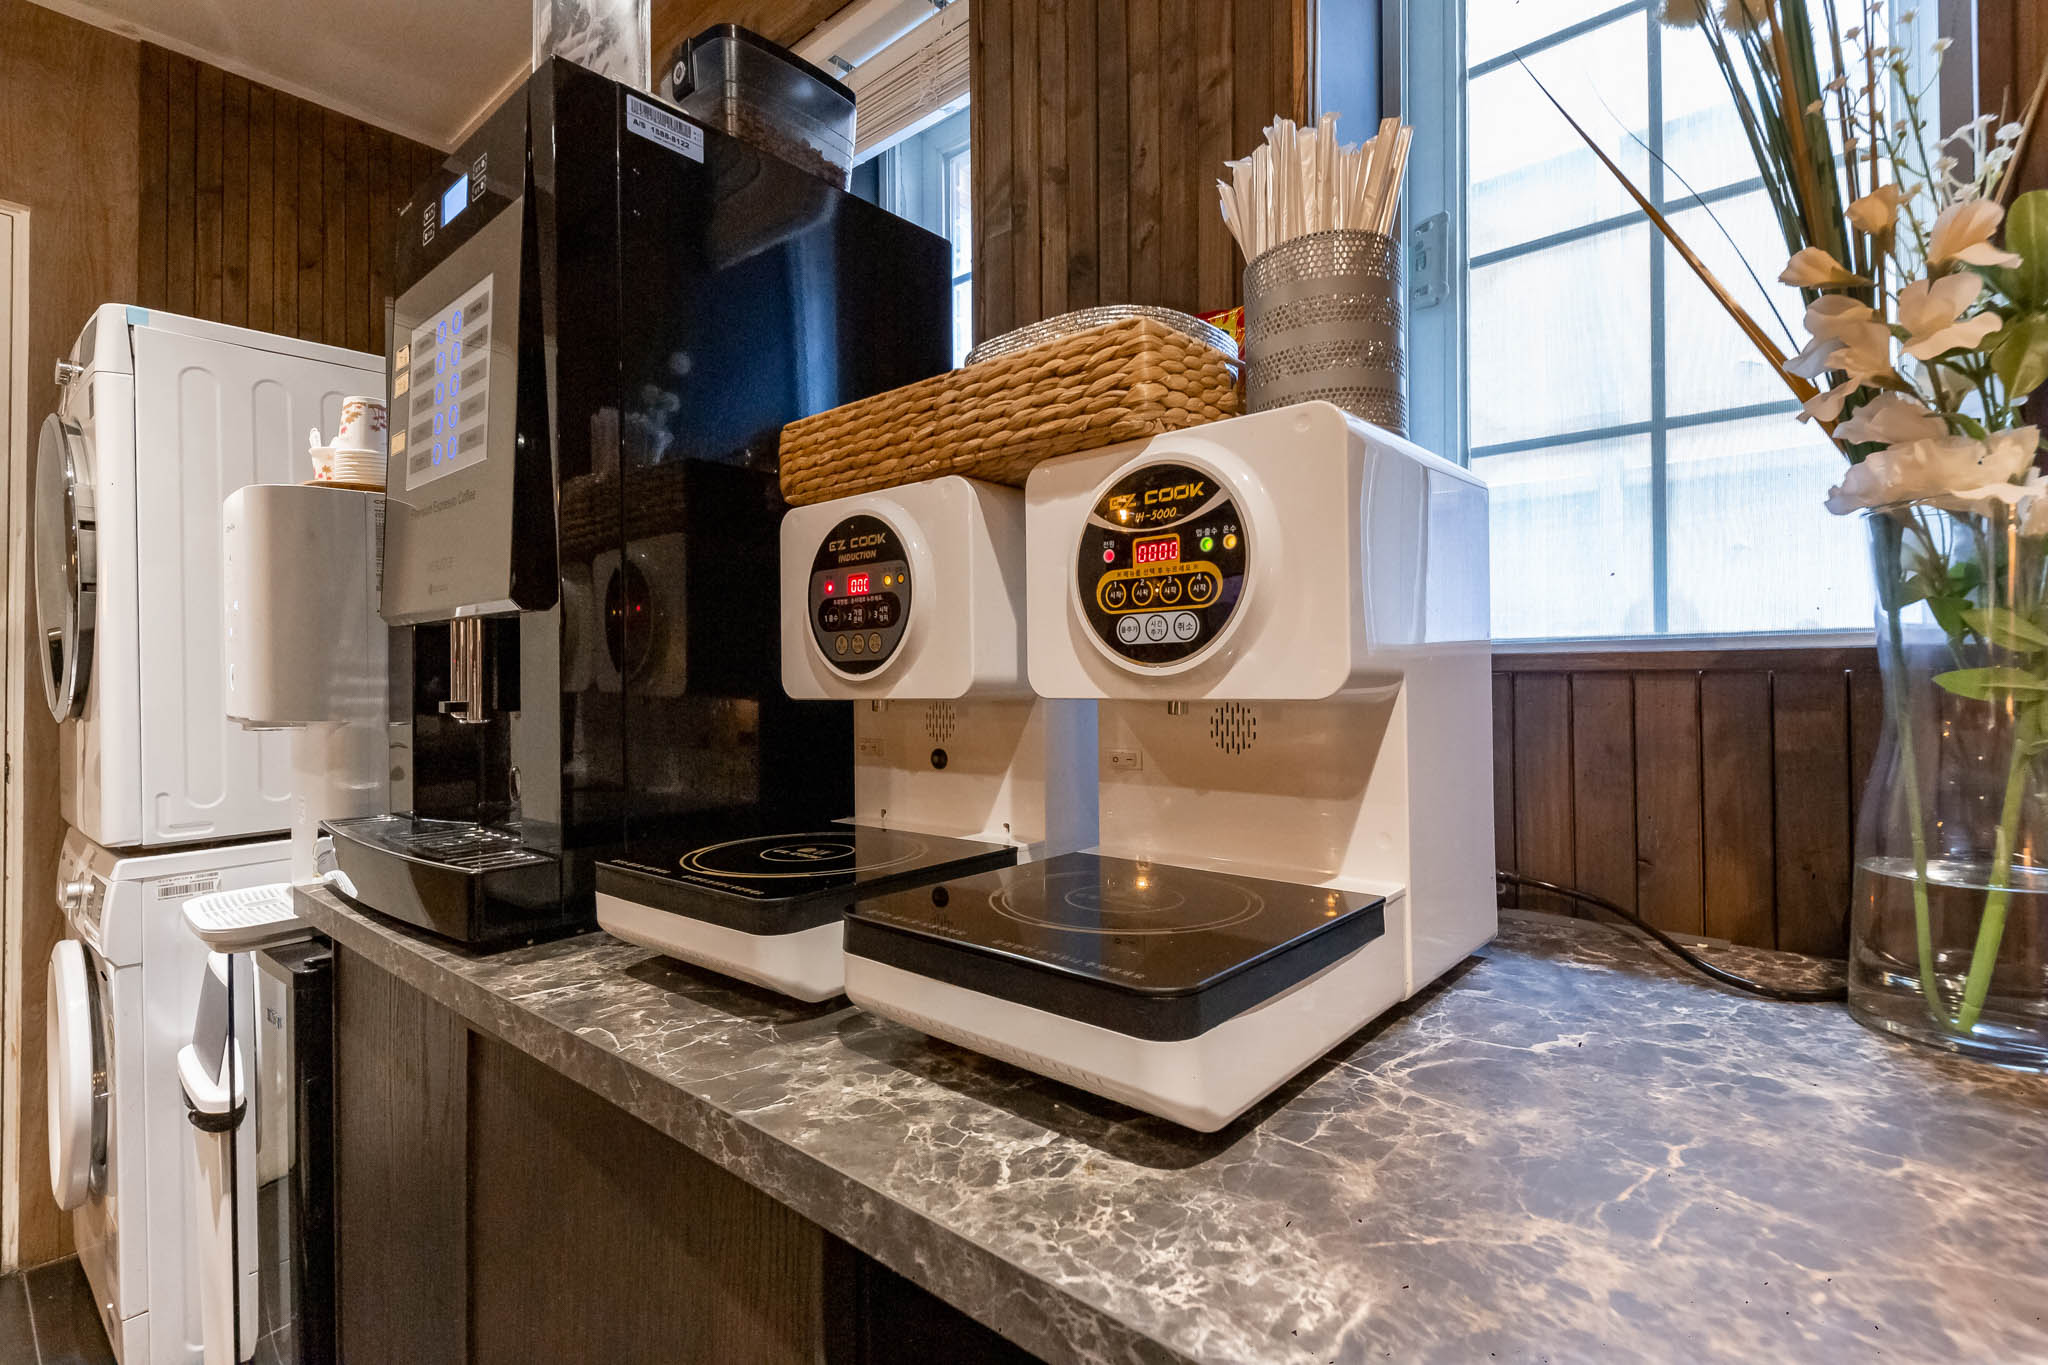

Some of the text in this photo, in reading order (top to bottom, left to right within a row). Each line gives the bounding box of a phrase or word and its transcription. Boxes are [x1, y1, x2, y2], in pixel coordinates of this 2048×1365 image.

[458, 489, 476, 504] Coffee
[1144, 482, 1205, 505] COOK
[829, 532, 886, 552] EZ COOK
[838, 550, 877, 563] INDUCTION
[1137, 542, 1178, 562] 0000
[1110, 591, 1121, 599] 시작
[1193, 584, 1206, 592] 시작
[1177, 623, 1194, 632] 취소
